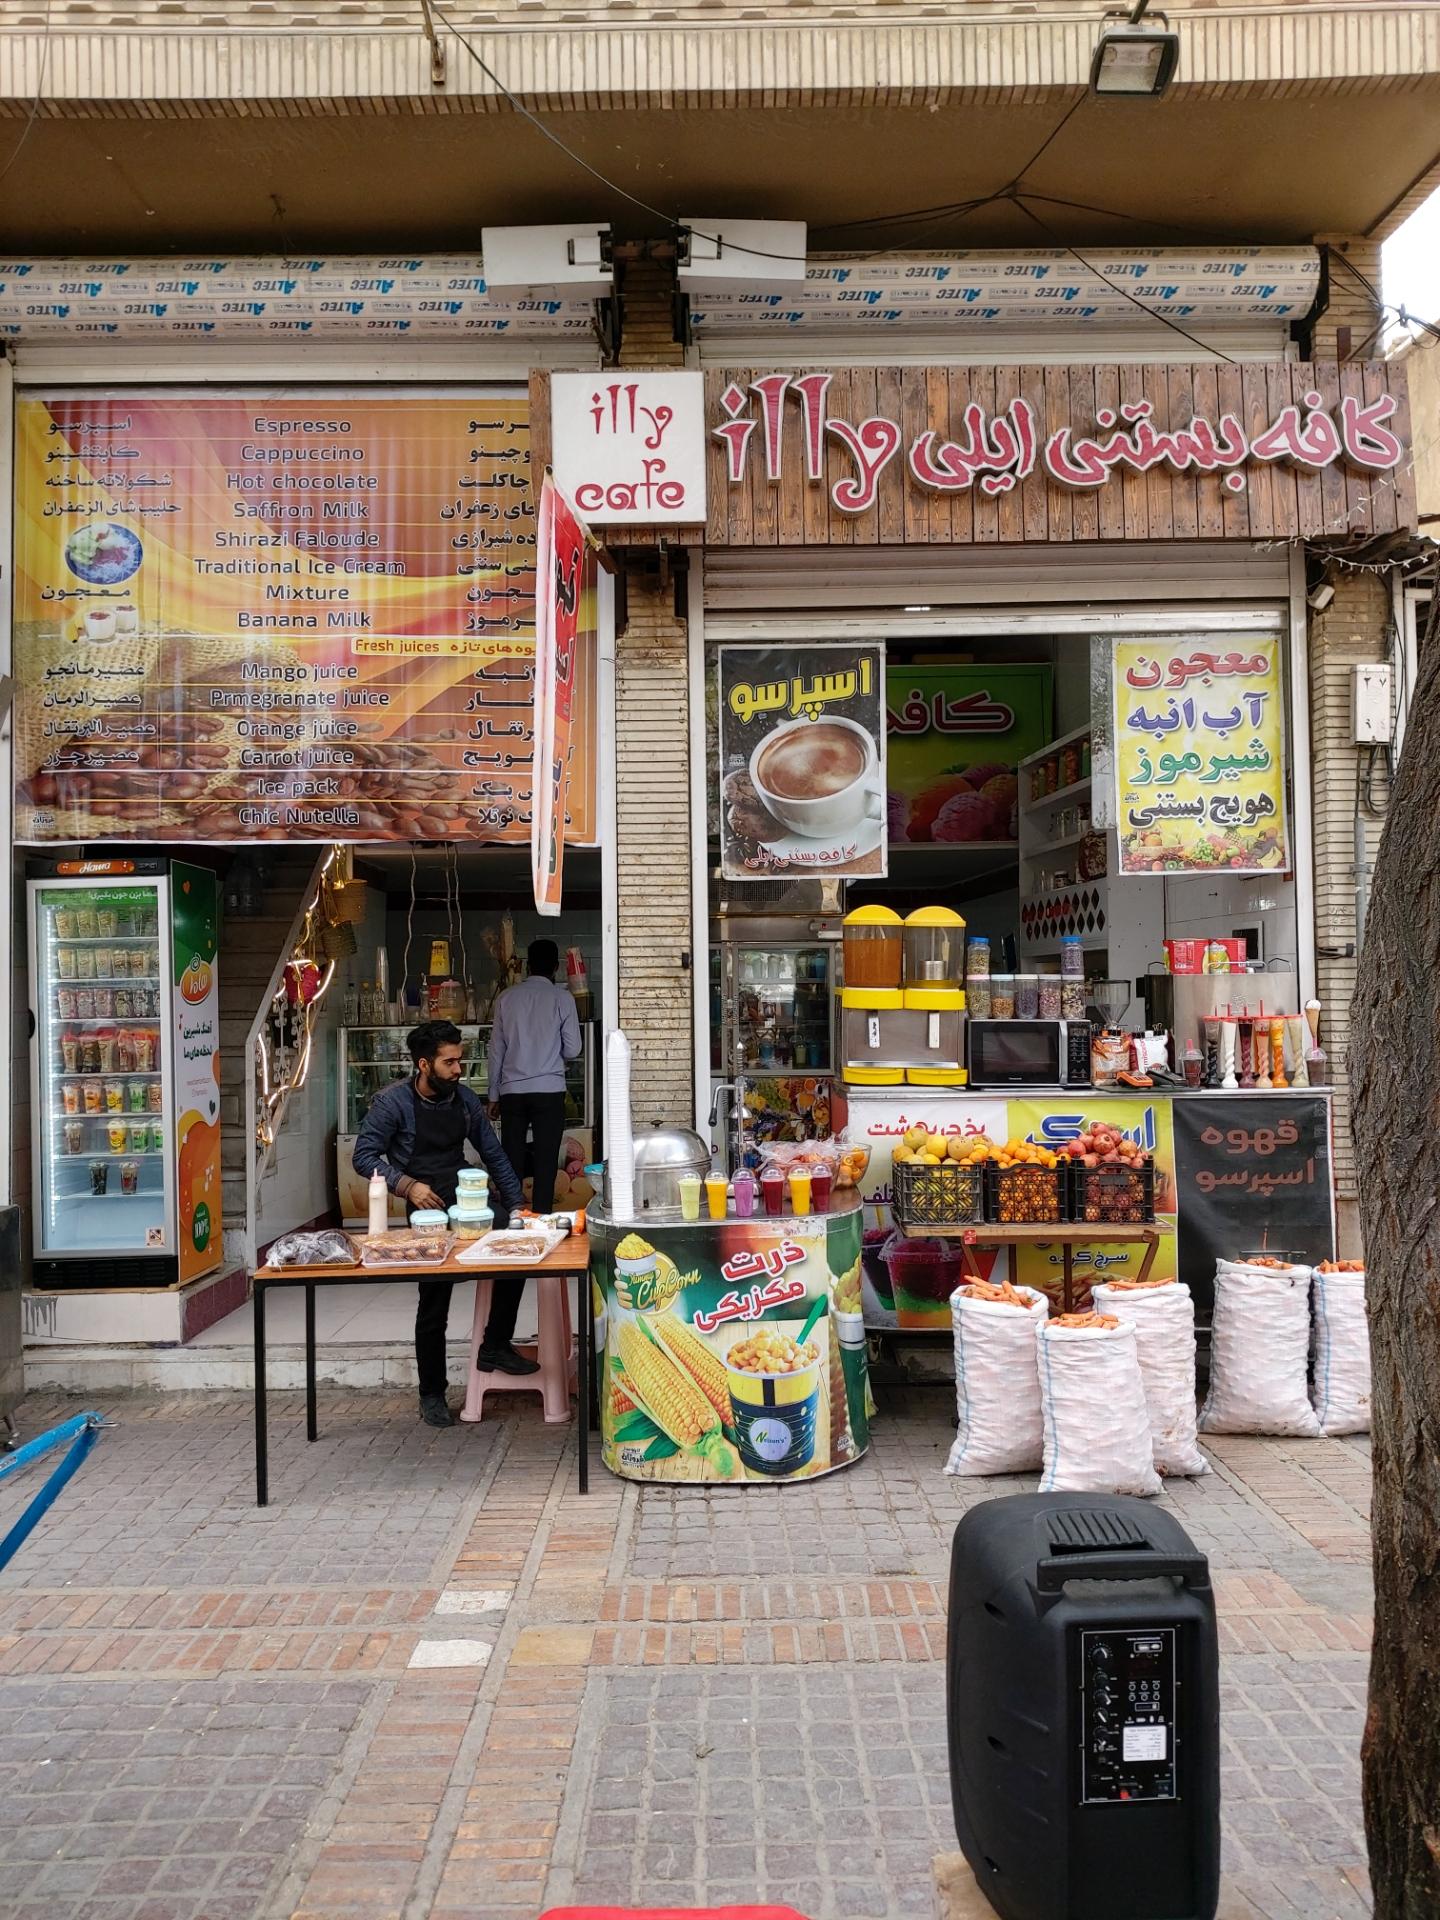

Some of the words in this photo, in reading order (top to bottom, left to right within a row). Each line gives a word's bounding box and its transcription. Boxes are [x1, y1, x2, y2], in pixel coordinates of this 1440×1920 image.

[85, 264, 131, 275] ALTEC
[183, 262, 228, 273] ALTEC
[280, 260, 326, 272] ALTEC
[378, 260, 423, 272] ALTEC
[1004, 265, 1050, 279] ALTEC
[1103, 264, 1150, 279] ALTEC
[1202, 263, 1248, 277] ALTEC
[806, 268, 852, 283] ALTEC
[905, 267, 952, 281] ALTEC
[58, 281, 103, 297] ALTEC
[156, 281, 200, 296] ALTEC
[252, 280, 298, 295] ALTEC
[350, 279, 395, 294] ALTEC
[1035, 287, 1082, 301] ALTEC
[1133, 285, 1180, 299] ALTEC
[1231, 285, 1278, 299] ALTEC
[837, 290, 884, 305] ALTEC
[936, 288, 983, 303] ALTEC
[26, 305, 71, 318] ALTEC
[124, 304, 168, 317] ALTEC
[221, 303, 266, 316] ALTEC
[320, 301, 364, 315] ALTEC
[418, 301, 464, 315] ALTEC
[517, 301, 562, 314] ALTEC
[955, 308, 1001, 320] ALTEC
[1053, 306, 1099, 317] ALTEC
[1248, 304, 1295, 315] ALTEC
[759, 311, 805, 323] ALTEC
[857, 310, 903, 321] ALTEC
[75, 323, 119, 333] ALTEC
[172, 322, 215, 332] ALTEC
[269, 321, 312, 331] ALTEC
[367, 321, 412, 331] ALTEC
[465, 320, 510, 330] ALTEC
[590, 384, 673, 450] illy
[254, 418, 352, 436] Espresso
[1250, 391, 1402, 471] کافه
[712, 373, 901, 512] illy
[908, 397, 1036, 495] ایلی
[1045, 400, 1250, 493] بستنی
[241, 445, 364, 464] Cappuccino
[227, 474, 264, 489] Hot
[272, 474, 378, 489] chocolate
[575, 458, 685, 511] cafe
[234, 502, 313, 517] Saffron
[323, 502, 368, 517] Milk
[440, 499, 500, 520] زعفران
[215, 532, 288, 547] Shirazi
[295, 531, 379, 547] Faloude
[452, 529, 513, 548] شیرازی
[194, 558, 301, 575] Traditional
[309, 558, 336, 574] Ice
[343, 558, 405, 574] Cream
[458, 556, 502, 576] سنتی
[41, 585, 131, 602] معجون
[265, 584, 350, 600] Mixture
[238, 612, 318, 628] Banana
[327, 611, 372, 628] Milk
[355, 639, 394, 652] Fresh
[400, 640, 440, 654] juices
[450, 641, 480, 655] تازه
[483, 643, 513, 655] های
[241, 663, 307, 682] Mango
[313, 663, 358, 682] juice
[1126, 651, 1270, 689] معجون
[210, 690, 337, 708] Prmegranate
[343, 689, 390, 708] juice
[730, 657, 872, 725] اسپرسو
[1126, 697, 1196, 744] انبه
[1202, 691, 1269, 738] آب
[237, 720, 306, 740] Orange
[312, 720, 358, 740] juice
[241, 749, 302, 765] Carrot
[307, 749, 354, 767] juice
[1199, 738, 1271, 782] شیر
[1129, 747, 1202, 785] موز
[258, 779, 286, 794] Ice
[292, 778, 339, 798] pack
[1128, 792, 1206, 828] بستنی
[1210, 791, 1276, 824] هویج
[239, 808, 280, 824] Chic
[286, 808, 360, 824] Nutella
[1200, 1119, 1299, 1155] قهوه
[1195, 1158, 1315, 1197] اسپرسو
[720, 1238, 809, 1284] ذرت
[1093, 1250, 1129, 1270] سرخ
[692, 1277, 809, 1336] مکزیکی
